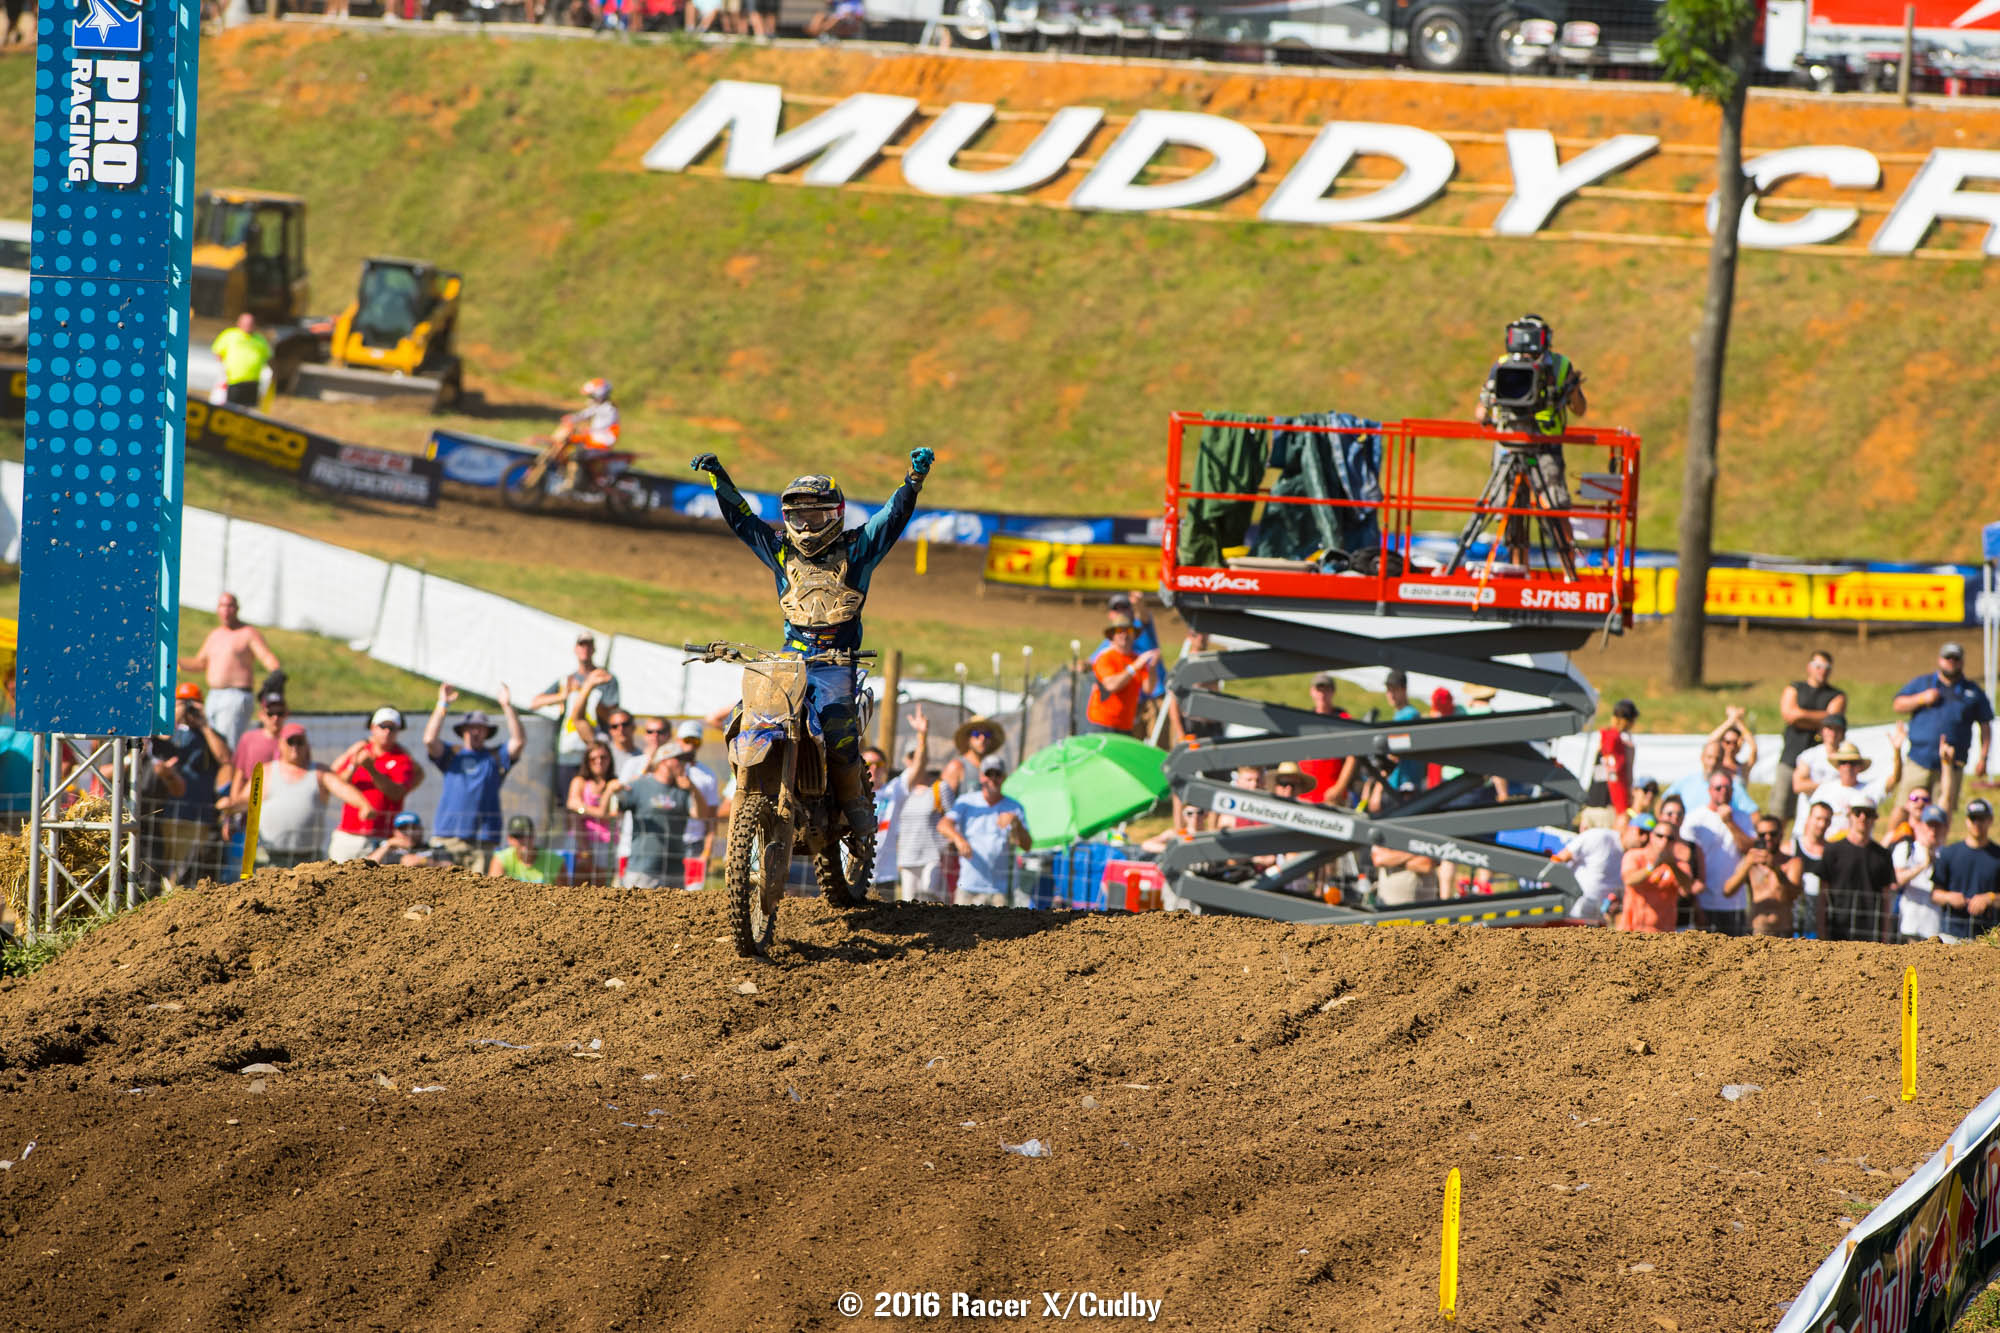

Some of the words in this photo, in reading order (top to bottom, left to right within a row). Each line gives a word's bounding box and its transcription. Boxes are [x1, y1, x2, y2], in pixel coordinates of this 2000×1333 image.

[68, 58, 93, 182] RACING
[93, 60, 140, 184] PRO
[642, 79, 1661, 236] MUDDY
[1177, 572, 1260, 591] SKYJACK
[1520, 587, 1581, 609] SJ7135
[1585, 591, 1609, 610] RT
[1240, 800, 1289, 821] United
[1291, 811, 1345, 832] Rentals
